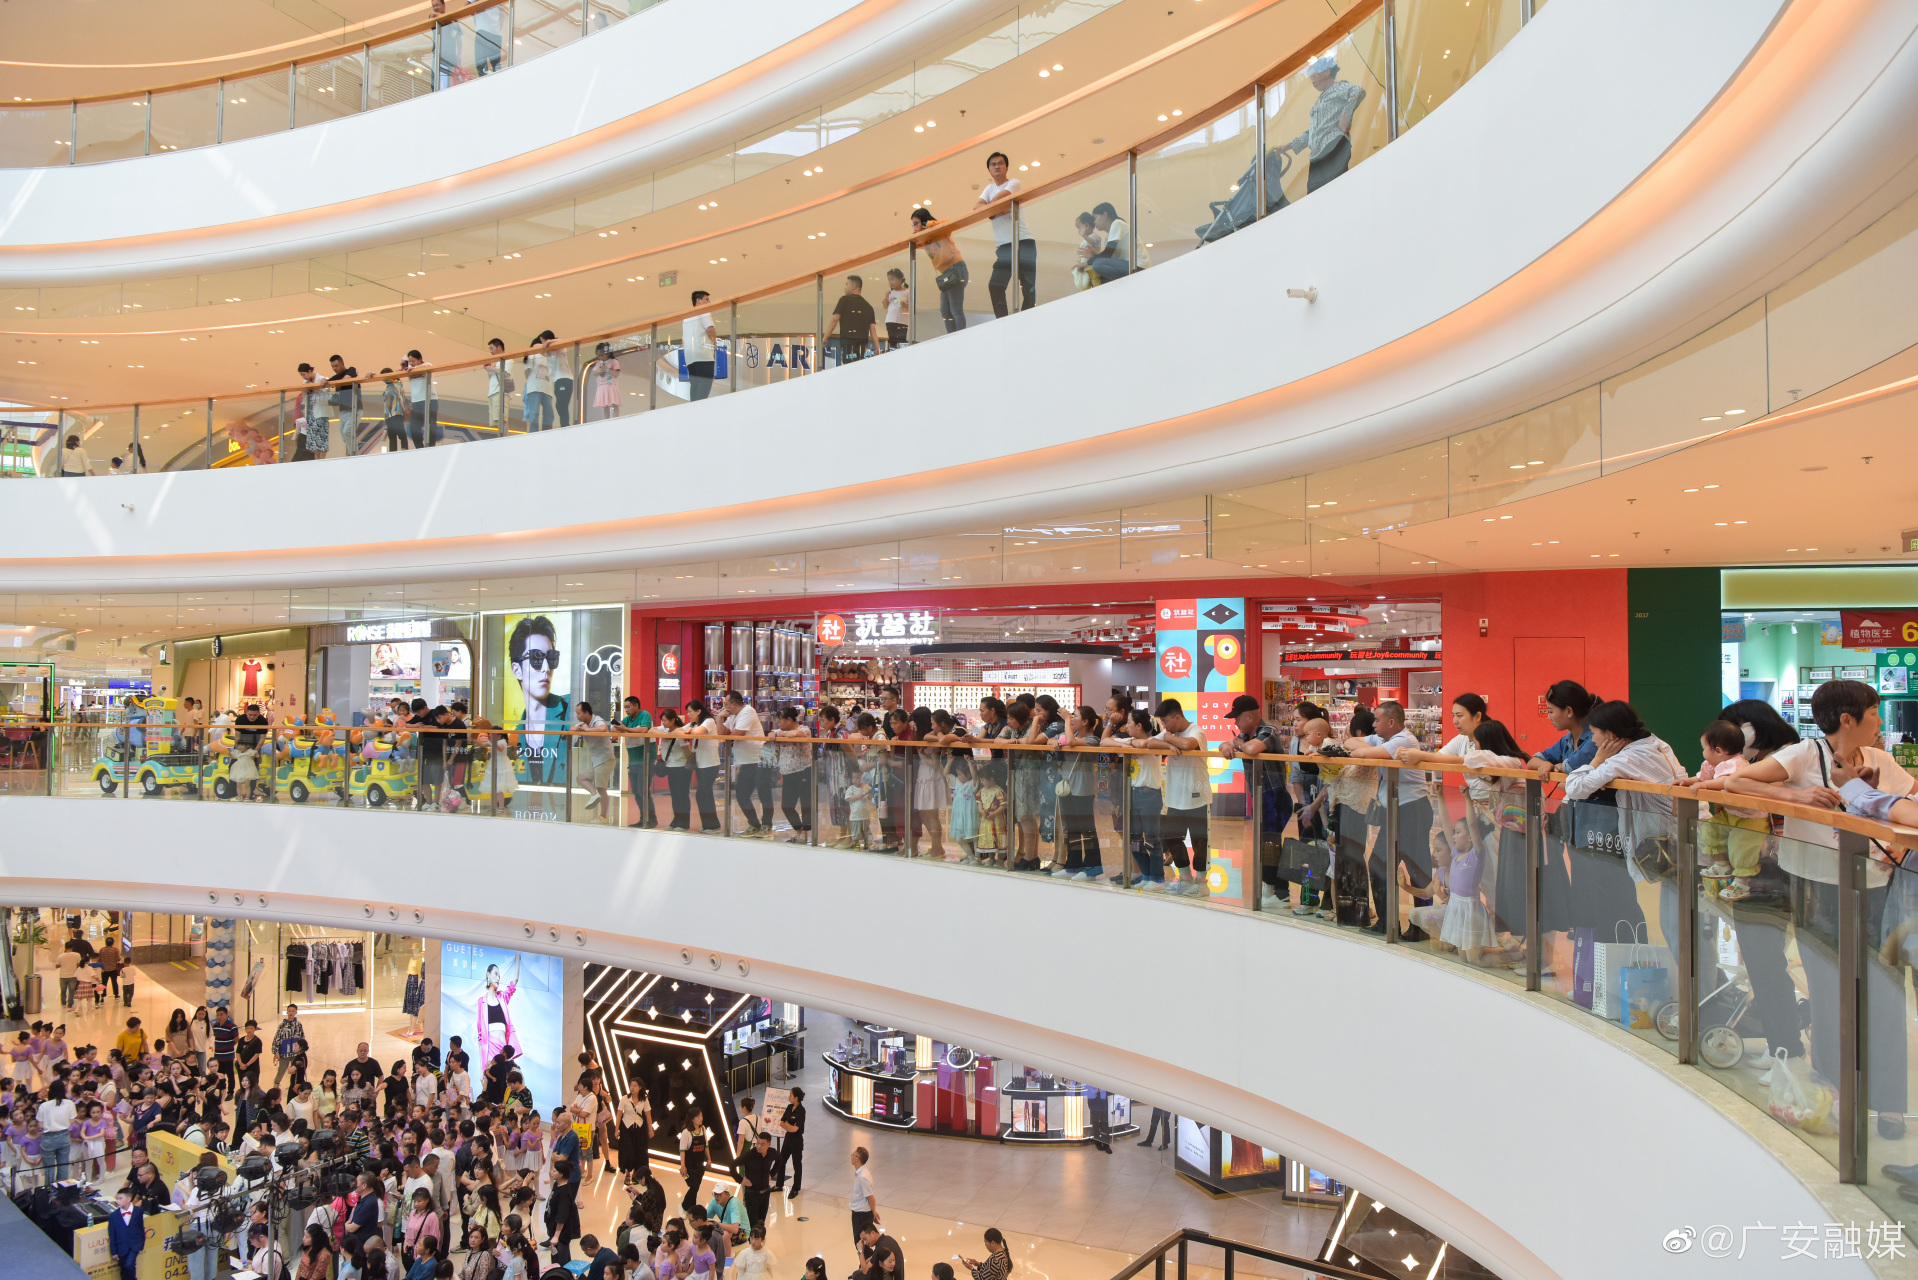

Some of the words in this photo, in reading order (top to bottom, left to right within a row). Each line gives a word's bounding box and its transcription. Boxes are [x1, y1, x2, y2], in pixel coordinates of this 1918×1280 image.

[822, 619, 841, 640] 社
[1850, 629, 1892, 639] 植物医生
[1165, 652, 1187, 673] 社
[446, 943, 484, 957] GUETES
